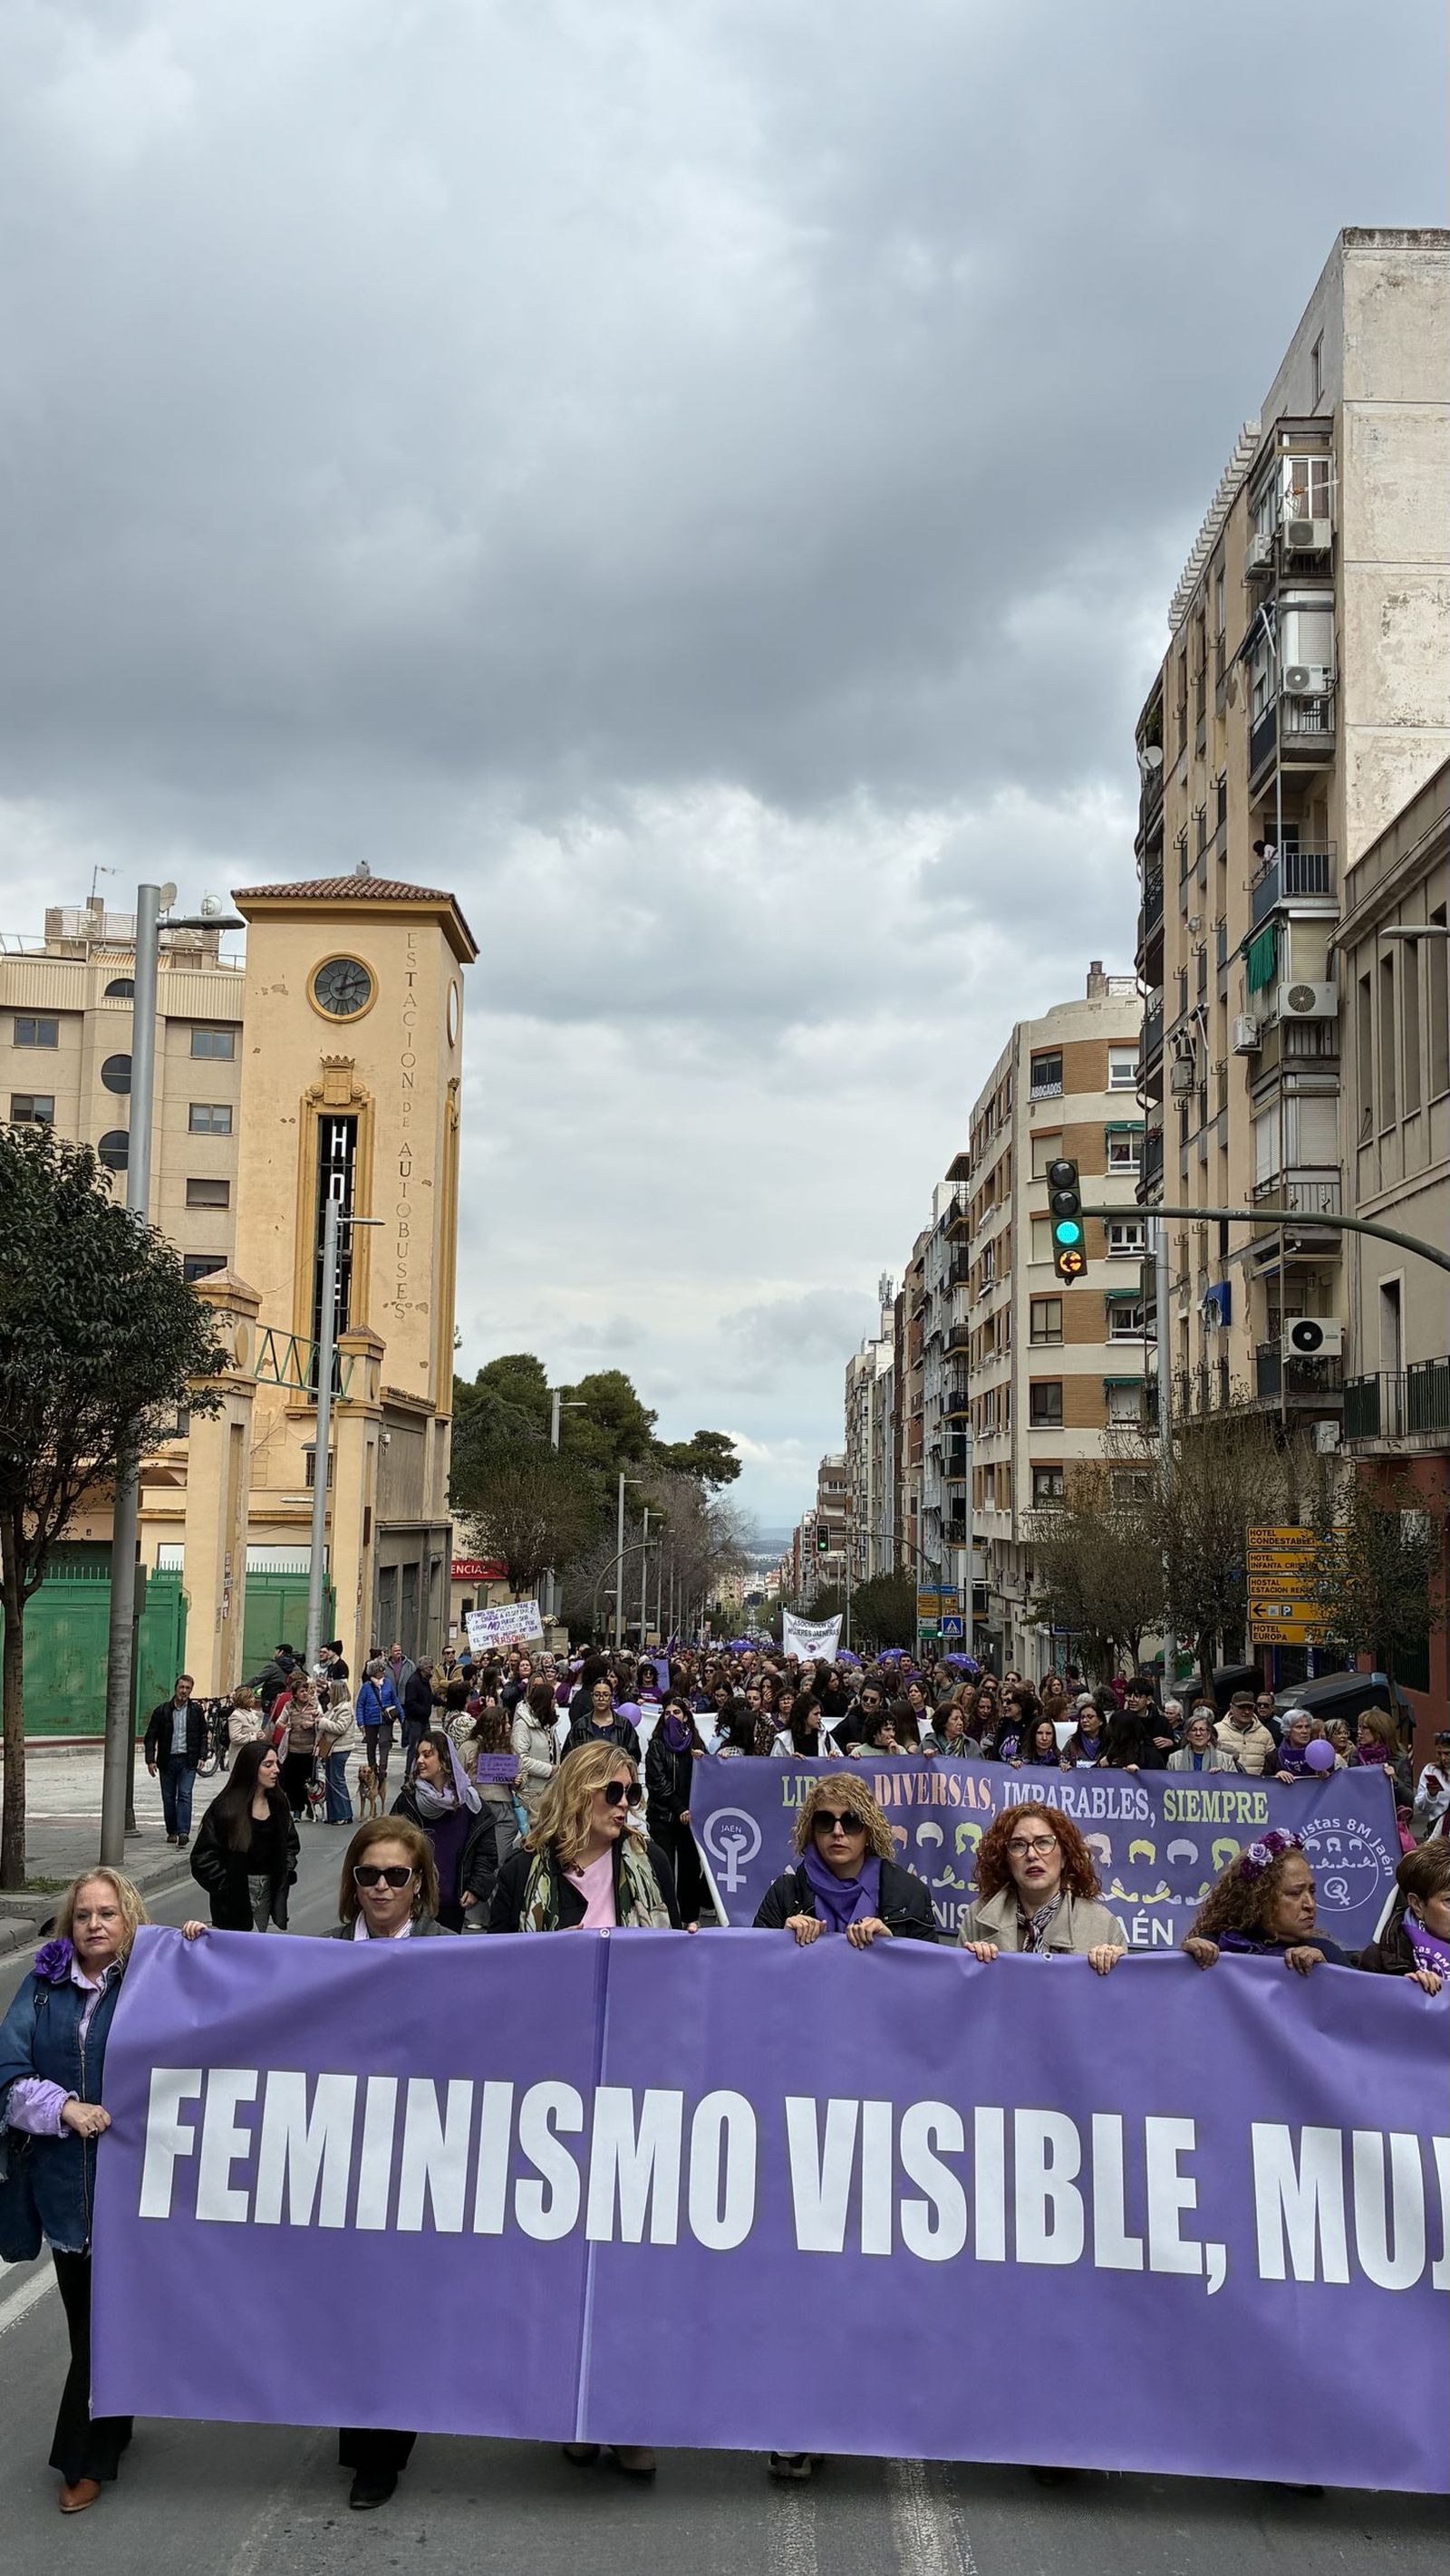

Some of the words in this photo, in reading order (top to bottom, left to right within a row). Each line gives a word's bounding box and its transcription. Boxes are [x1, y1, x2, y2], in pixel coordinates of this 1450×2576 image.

[402, 1102, 411, 1128] DE
[394, 1142, 412, 1320] AUTOBUSES
[488, 1621, 500, 1631] NO
[1253, 1633, 1287, 1641] EUROPA
[874, 1772, 996, 1817] DIVERSAS,
[1003, 1781, 1155, 1828] IMPARABLES,
[1164, 1789, 1269, 1824] SIEMPRE
[1347, 1819, 1372, 1838] 8M
[1368, 1837, 1394, 1876] Jaén
[139, 2067, 758, 2250] FEMINISMO
[785, 2096, 1227, 2295] VISIBLE,
